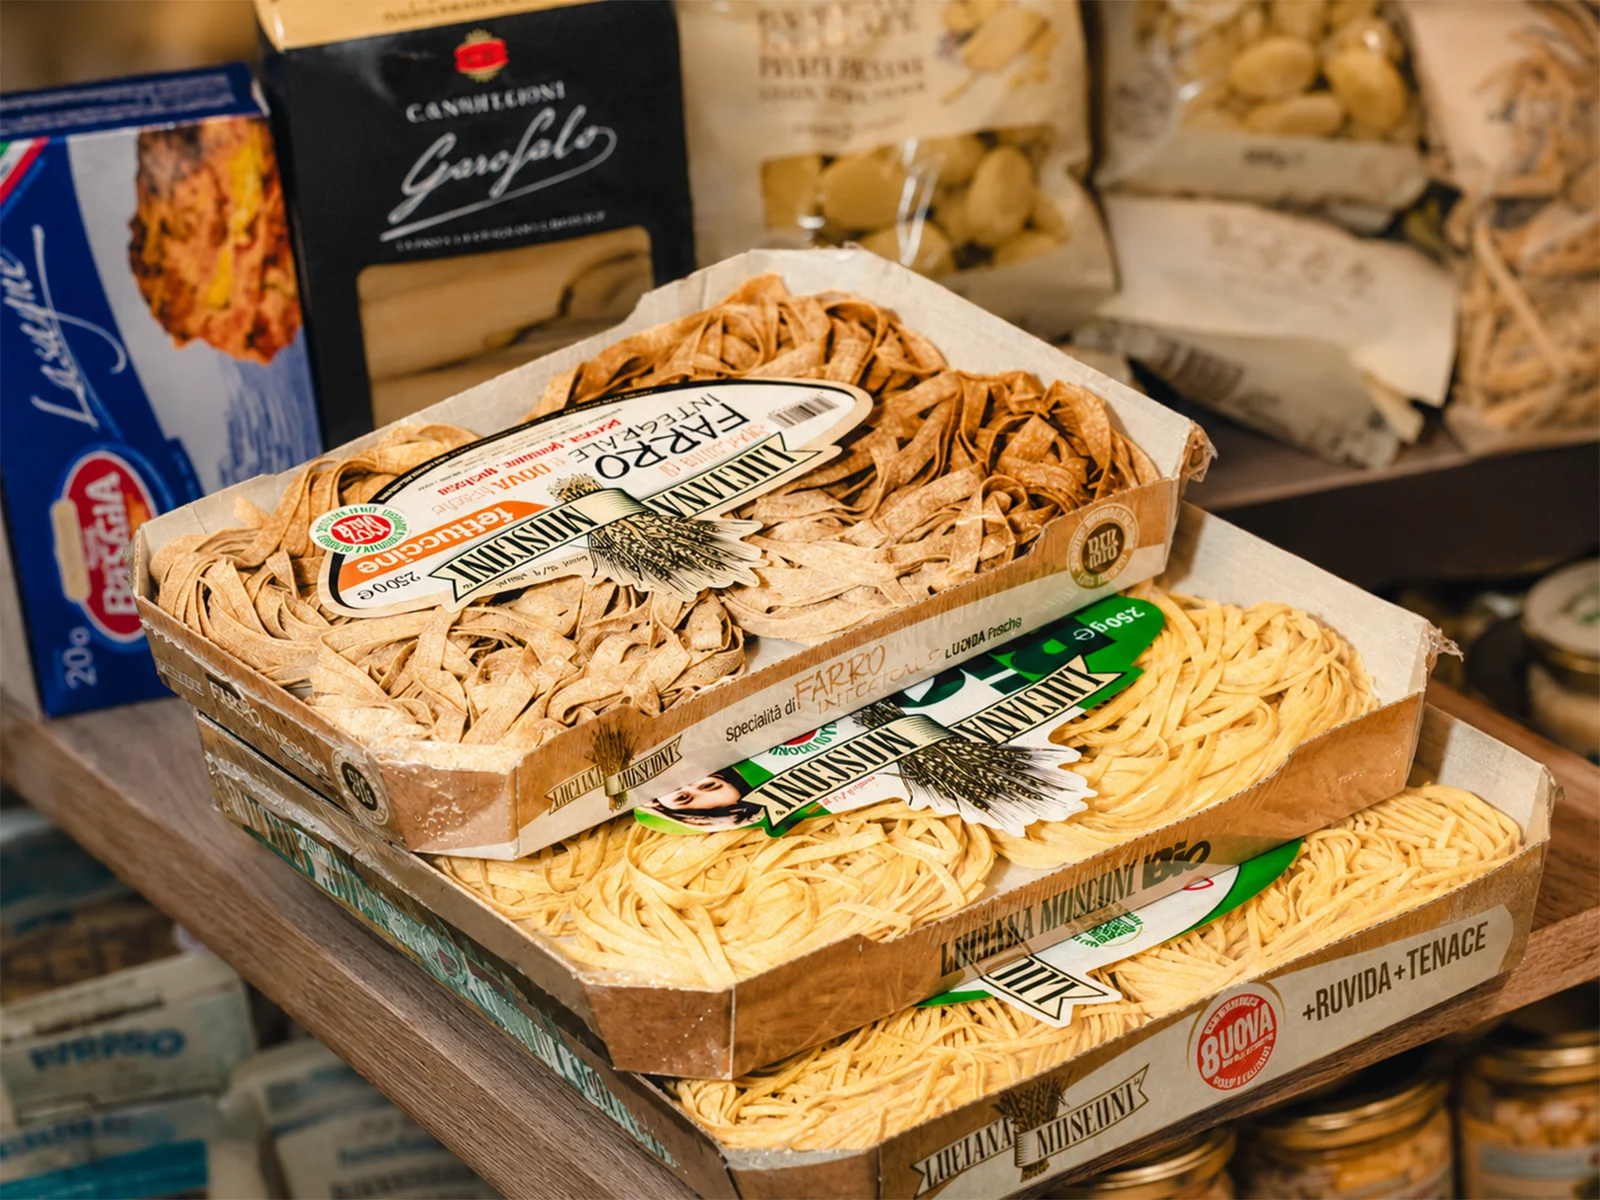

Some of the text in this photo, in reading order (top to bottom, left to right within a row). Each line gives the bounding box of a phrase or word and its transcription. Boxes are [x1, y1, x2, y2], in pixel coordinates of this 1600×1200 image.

[380, 104, 617, 240] Garofalo
[568, 393, 720, 464] INTEGRALE
[595, 403, 750, 480] FARRO
[647, 444, 797, 518] LUCIANA
[357, 507, 515, 574] fettuccine
[447, 505, 598, 586] MOSCONI
[794, 644, 886, 710] FARRO
[950, 665, 1105, 746] LUCIANA
[756, 725, 917, 810] MOSCONI
